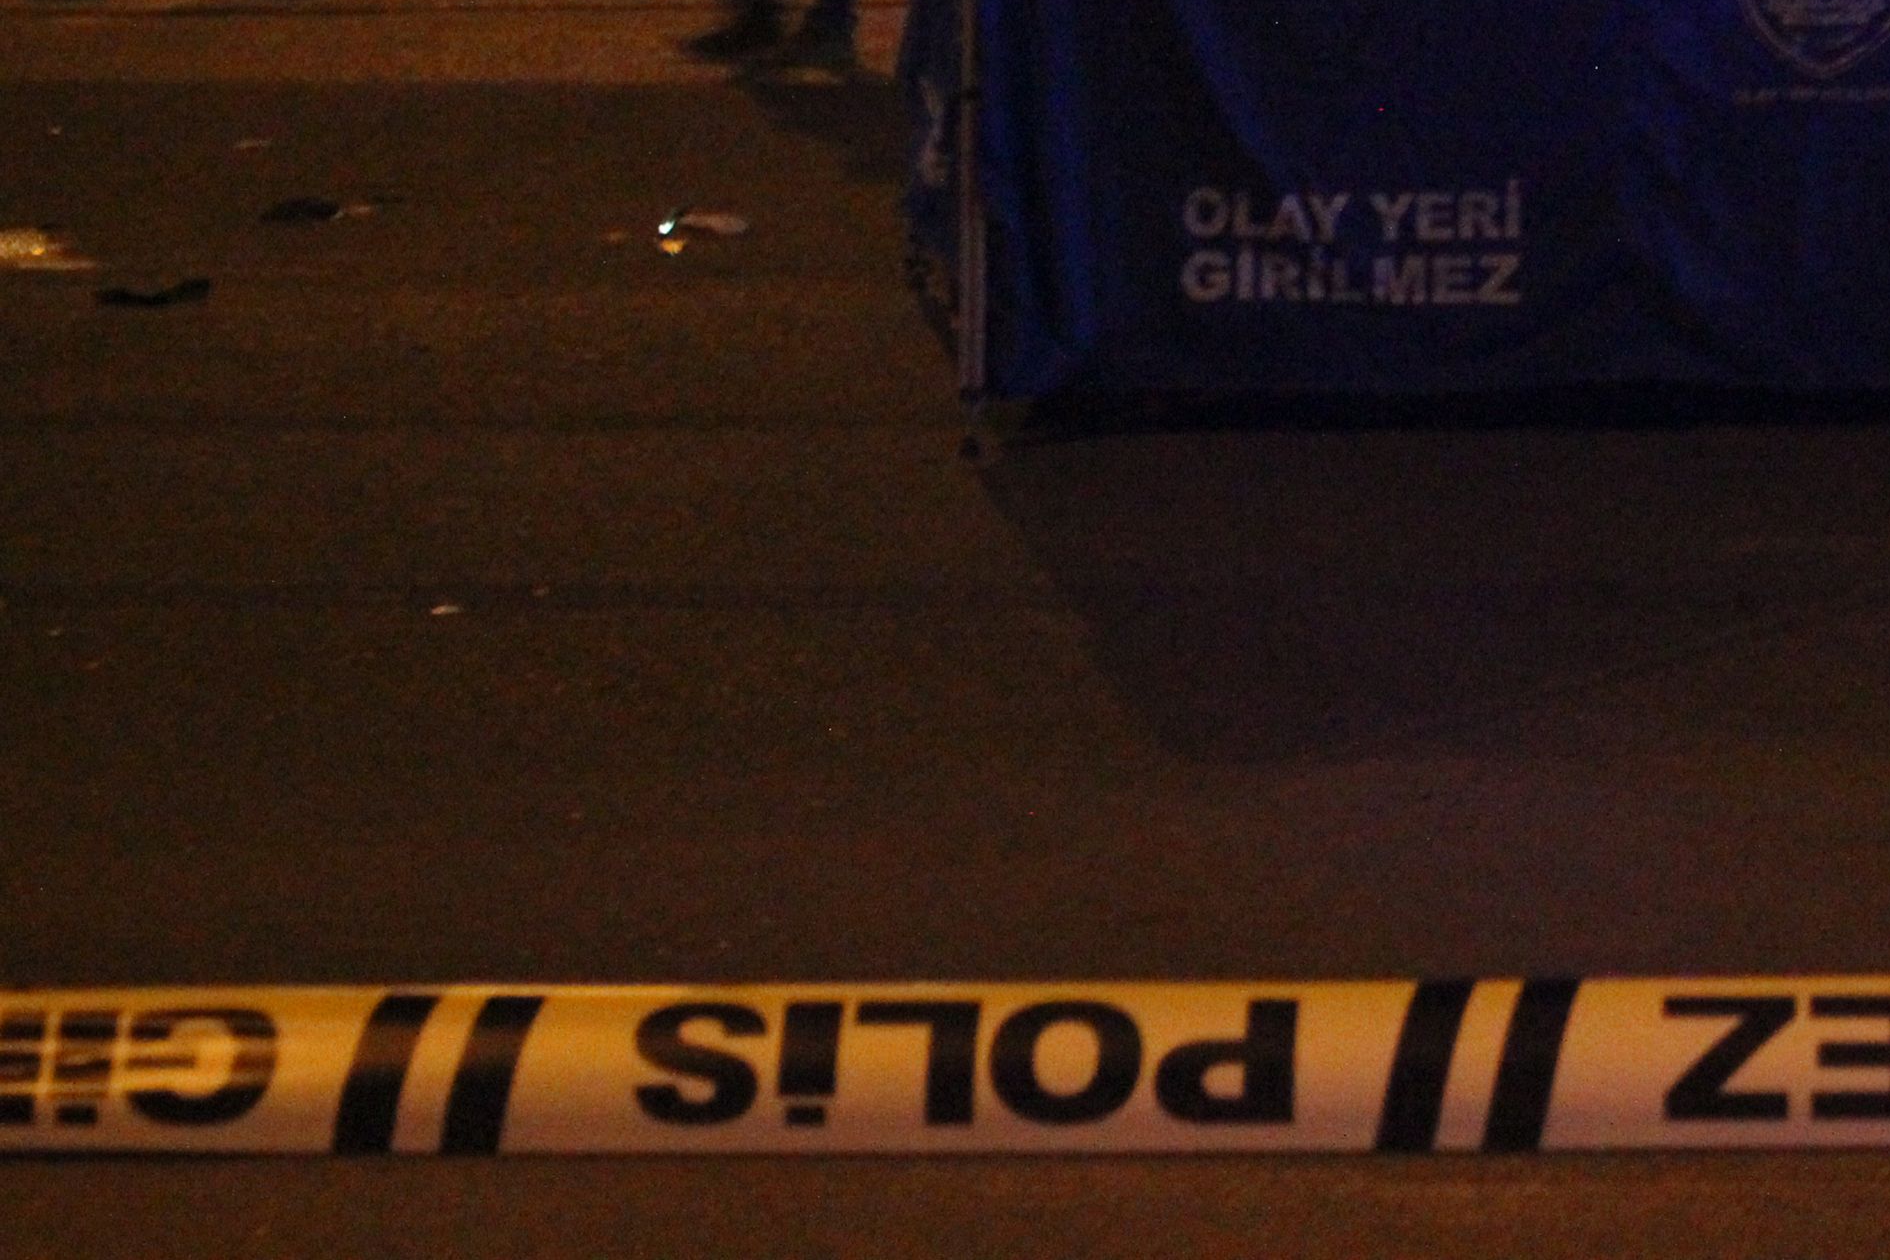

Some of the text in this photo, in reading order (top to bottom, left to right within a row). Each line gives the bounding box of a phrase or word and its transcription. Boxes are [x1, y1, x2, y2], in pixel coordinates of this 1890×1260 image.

[1182, 178, 1522, 240] OLAY YERİ
[1180, 243, 1523, 306] GİRİLMEZ
